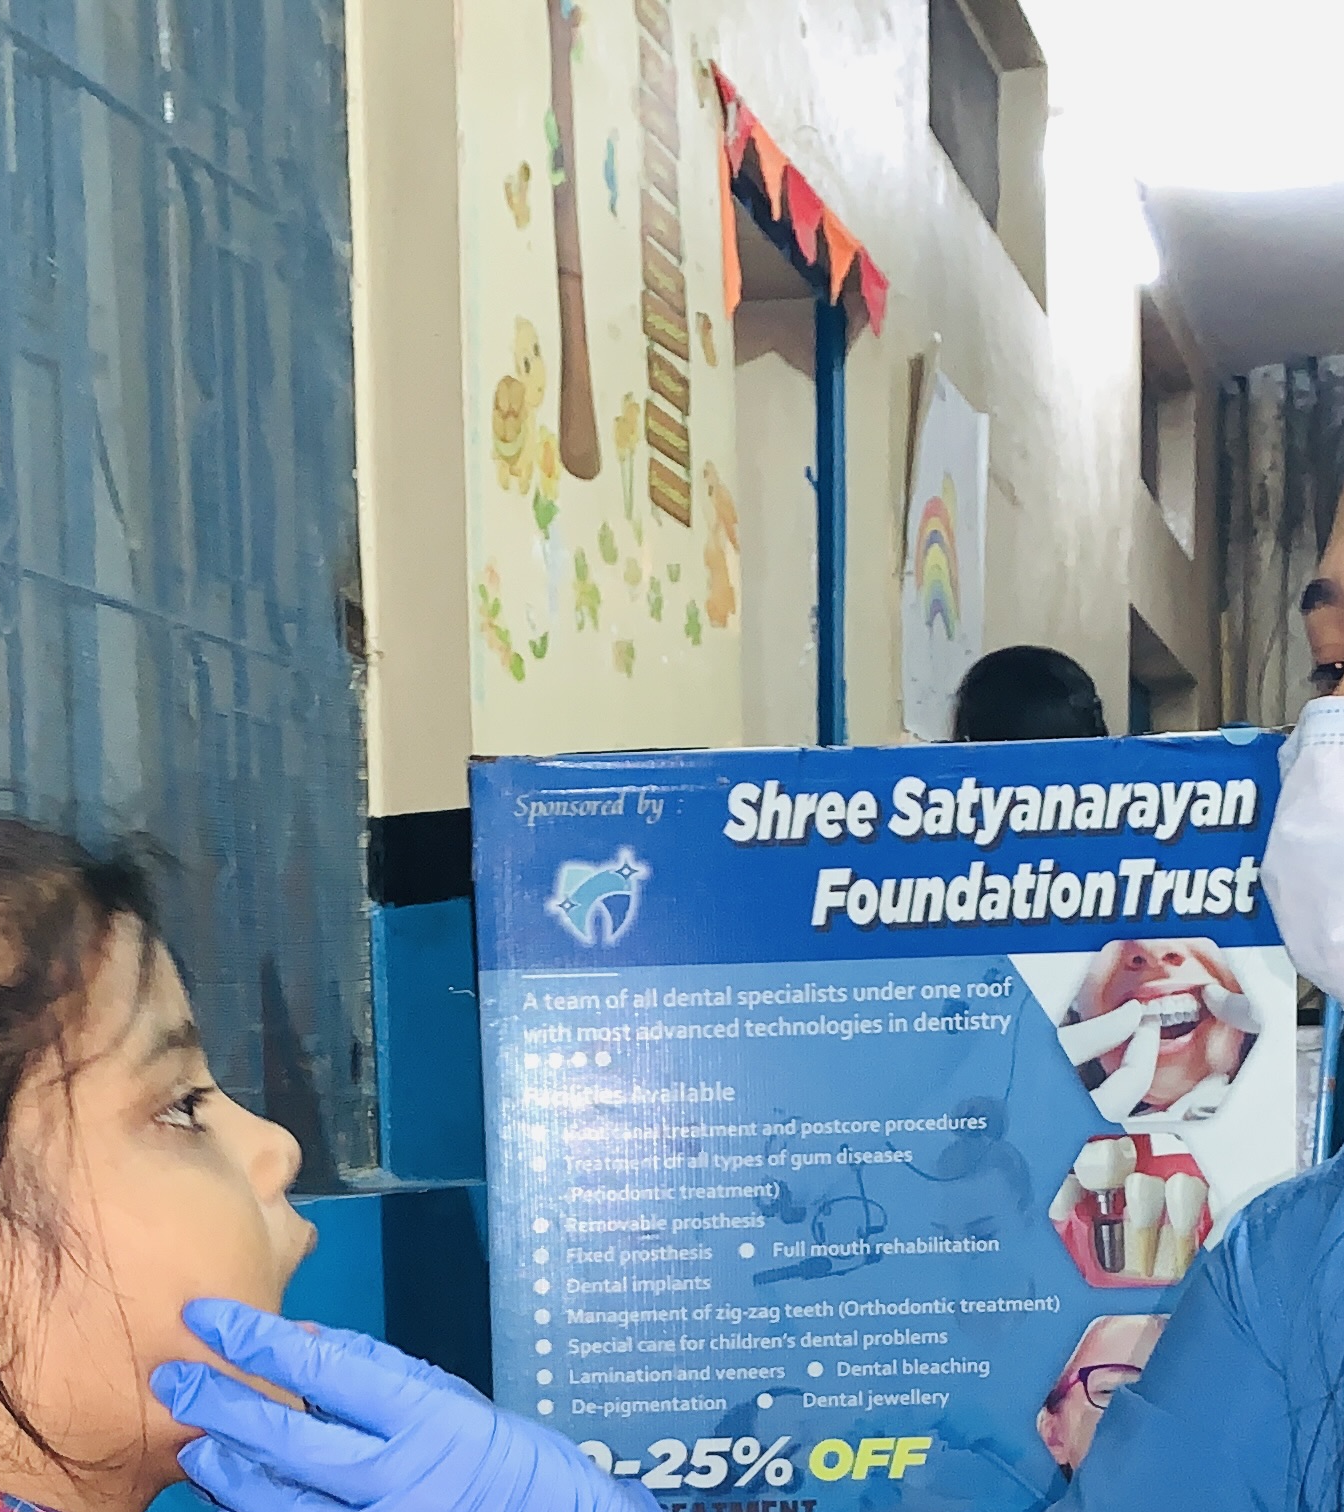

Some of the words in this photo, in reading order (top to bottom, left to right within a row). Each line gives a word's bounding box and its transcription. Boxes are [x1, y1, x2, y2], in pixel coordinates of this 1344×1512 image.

[513, 791, 626, 826] Sponsored
[636, 794, 666, 824] by
[724, 779, 879, 843] Shree
[889, 776, 1257, 846] Satyanarayan
[522, 992, 539, 1011] A
[544, 993, 600, 1010] team
[606, 988, 629, 1010] of
[634, 987, 658, 1009] all
[663, 986, 733, 1008] dental
[737, 982, 848, 1011] specialists
[853, 980, 916, 1001] under
[921, 982, 961, 1000] one
[967, 976, 1013, 998] roof
[523, 1022, 572, 1043] with
[577, 1024, 631, 1042] most
[636, 1018, 740, 1040] advanced
[744, 1012, 883, 1041] technologies
[888, 1012, 908, 1033] in
[913, 1011, 1012, 1035] dentistry
[665, 1121, 758, 1139] treatment
[762, 1118, 796, 1136] and
[800, 1119, 881, 1139] postcore
[885, 1114, 988, 1136] procedures
[664, 1151, 685, 1170] of
[714, 1153, 763, 1173] types
[767, 1148, 788, 1167] of
[791, 1151, 832, 1171] gum
[836, 1148, 914, 1165] diseases
[680, 1182, 780, 1201] treatment)
[566, 1213, 667, 1234] Removable
[672, 1211, 766, 1234] prosthesis
[566, 1246, 615, 1264] Fixed
[620, 1243, 713, 1266] prosthesis
[772, 1240, 806, 1258] Full
[810, 1238, 872, 1257] mouth
[875, 1235, 1000, 1255] rehabilitation
[566, 1275, 627, 1294] Dental
[632, 1274, 712, 1297] implants
[566, 1305, 688, 1328] Management
[692, 1303, 712, 1321] of
[715, 1303, 781, 1324] zig-zag
[784, 1300, 834, 1319] teeth
[838, 1297, 956, 1320] (Orthodontic
[960, 1294, 1061, 1315] treatment)
[567, 1335, 633, 1358] Special
[637, 1337, 676, 1353] care
[679, 1334, 706, 1352] for
[709, 1332, 796, 1351] children's
[800, 1329, 859, 1348] dental
[863, 1328, 949, 1351] problems
[569, 1365, 672, 1386] Lamination
[674, 1364, 711, 1382] and
[715, 1365, 786, 1382] veneers
[836, 1358, 897, 1377] Dental
[902, 1356, 991, 1378] bleaching
[571, 1393, 727, 1418] De-pigmentation
[802, 1390, 863, 1408] Dental
[865, 1388, 950, 1412] jewellery
[808, 1436, 933, 1482] OFF
